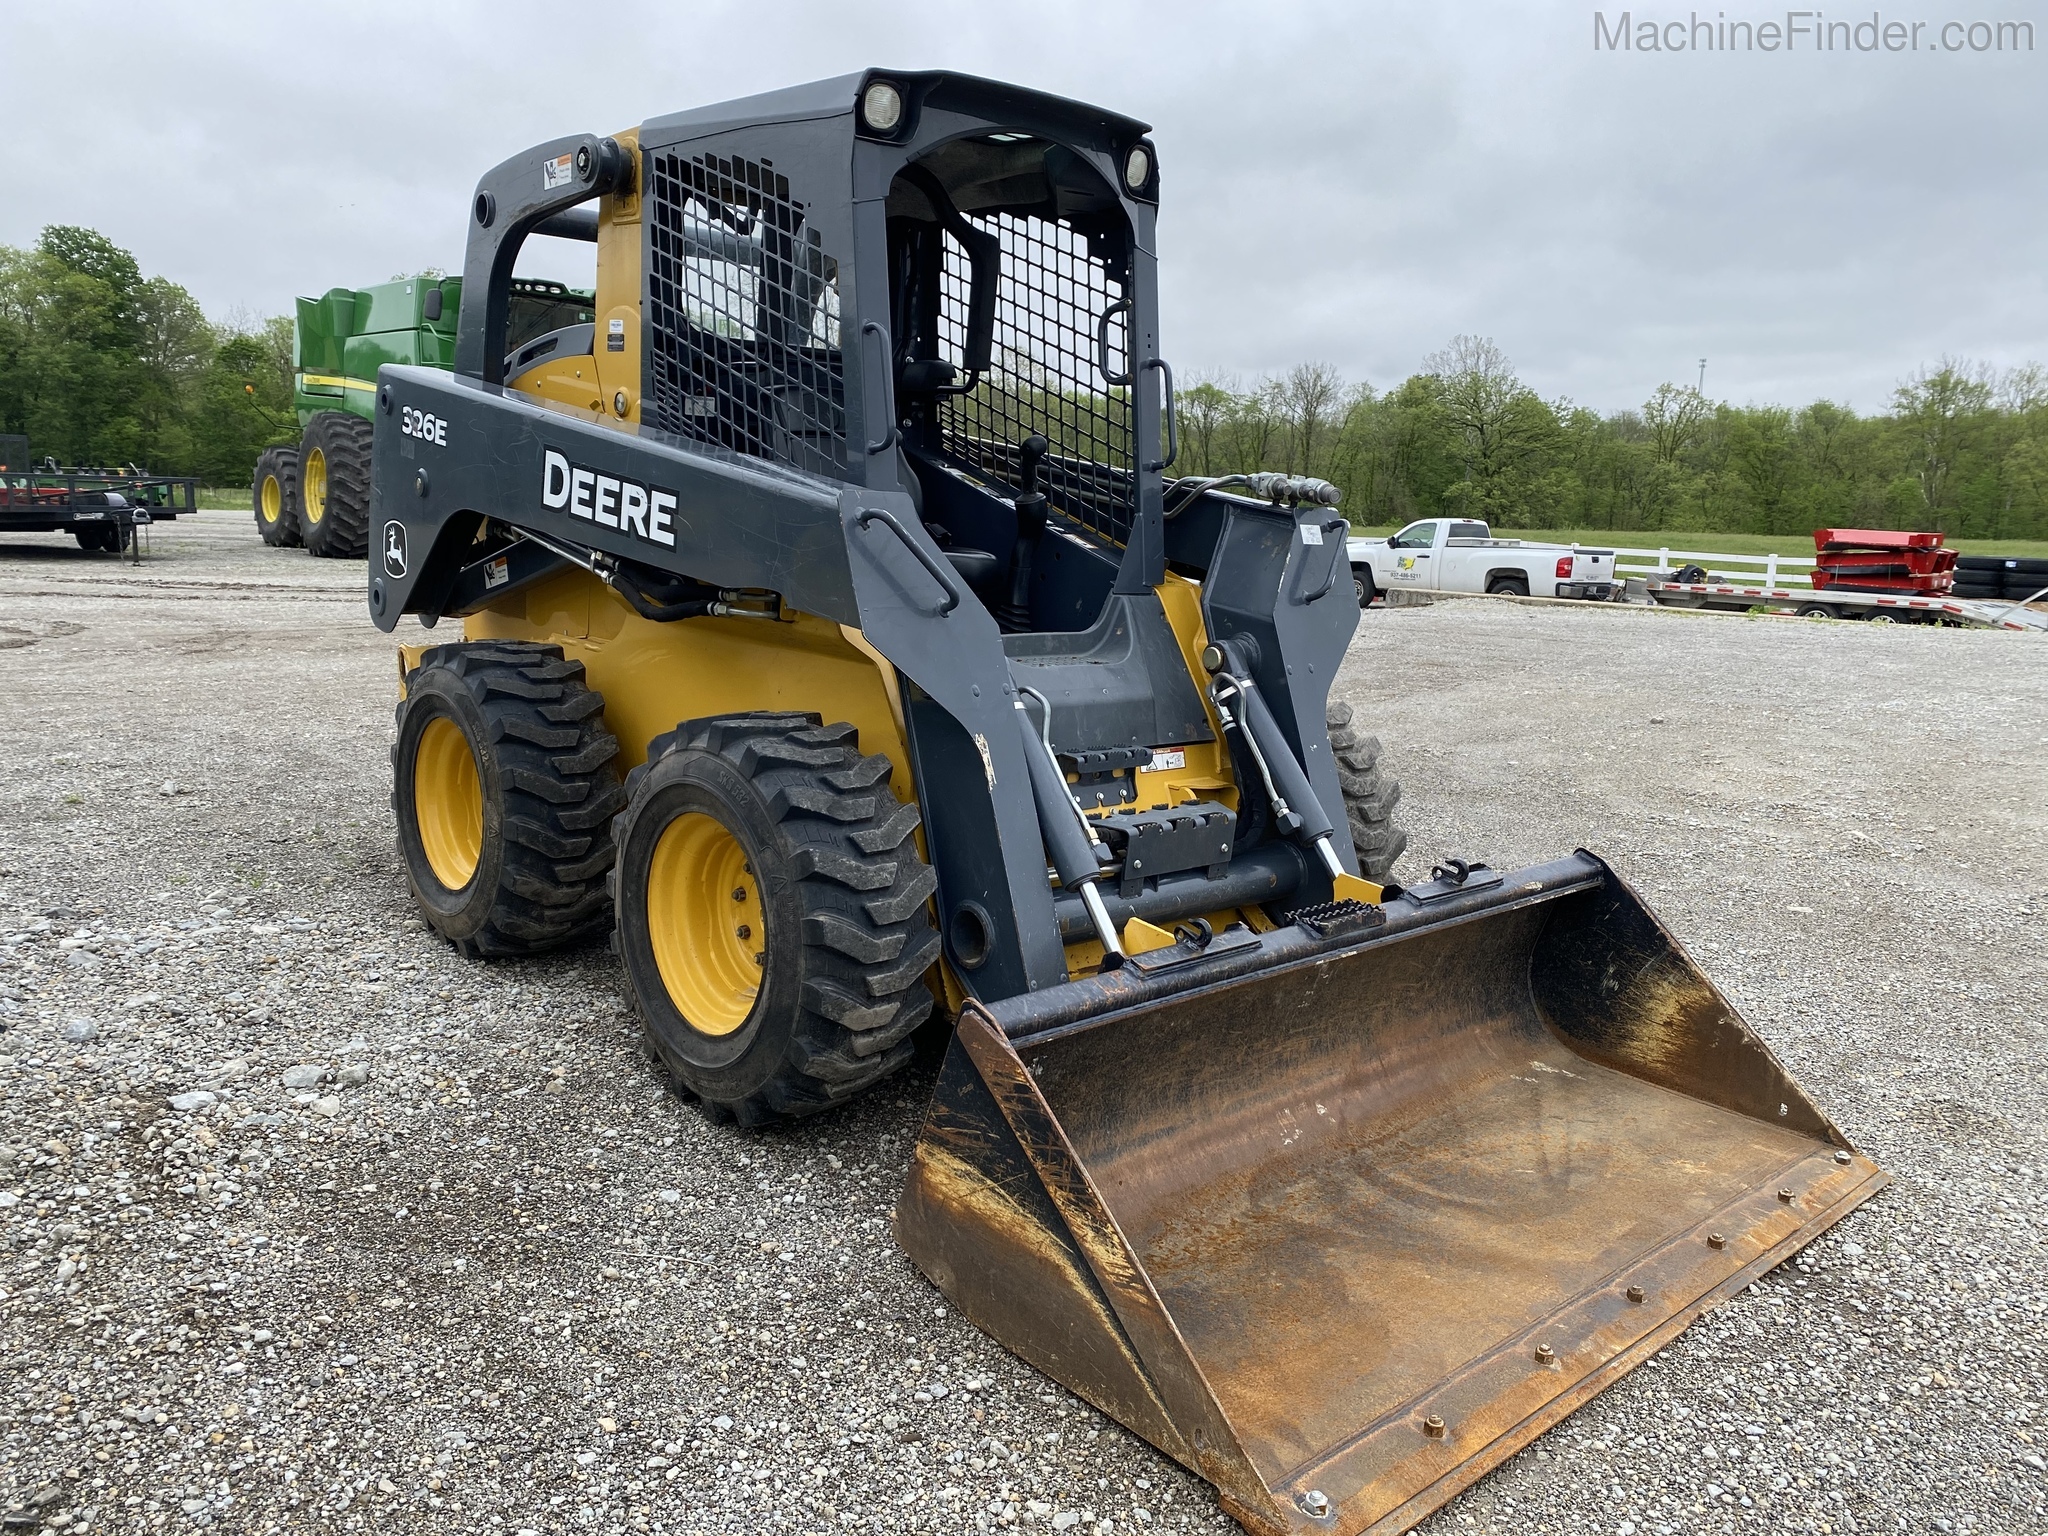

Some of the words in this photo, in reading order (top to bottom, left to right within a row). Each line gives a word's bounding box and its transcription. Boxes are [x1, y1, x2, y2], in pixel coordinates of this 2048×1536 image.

[402, 405, 448, 447] 326E
[542, 449, 677, 547] DEERE
[717, 770, 735, 791] SKS
[731, 784, 751, 808] 532
